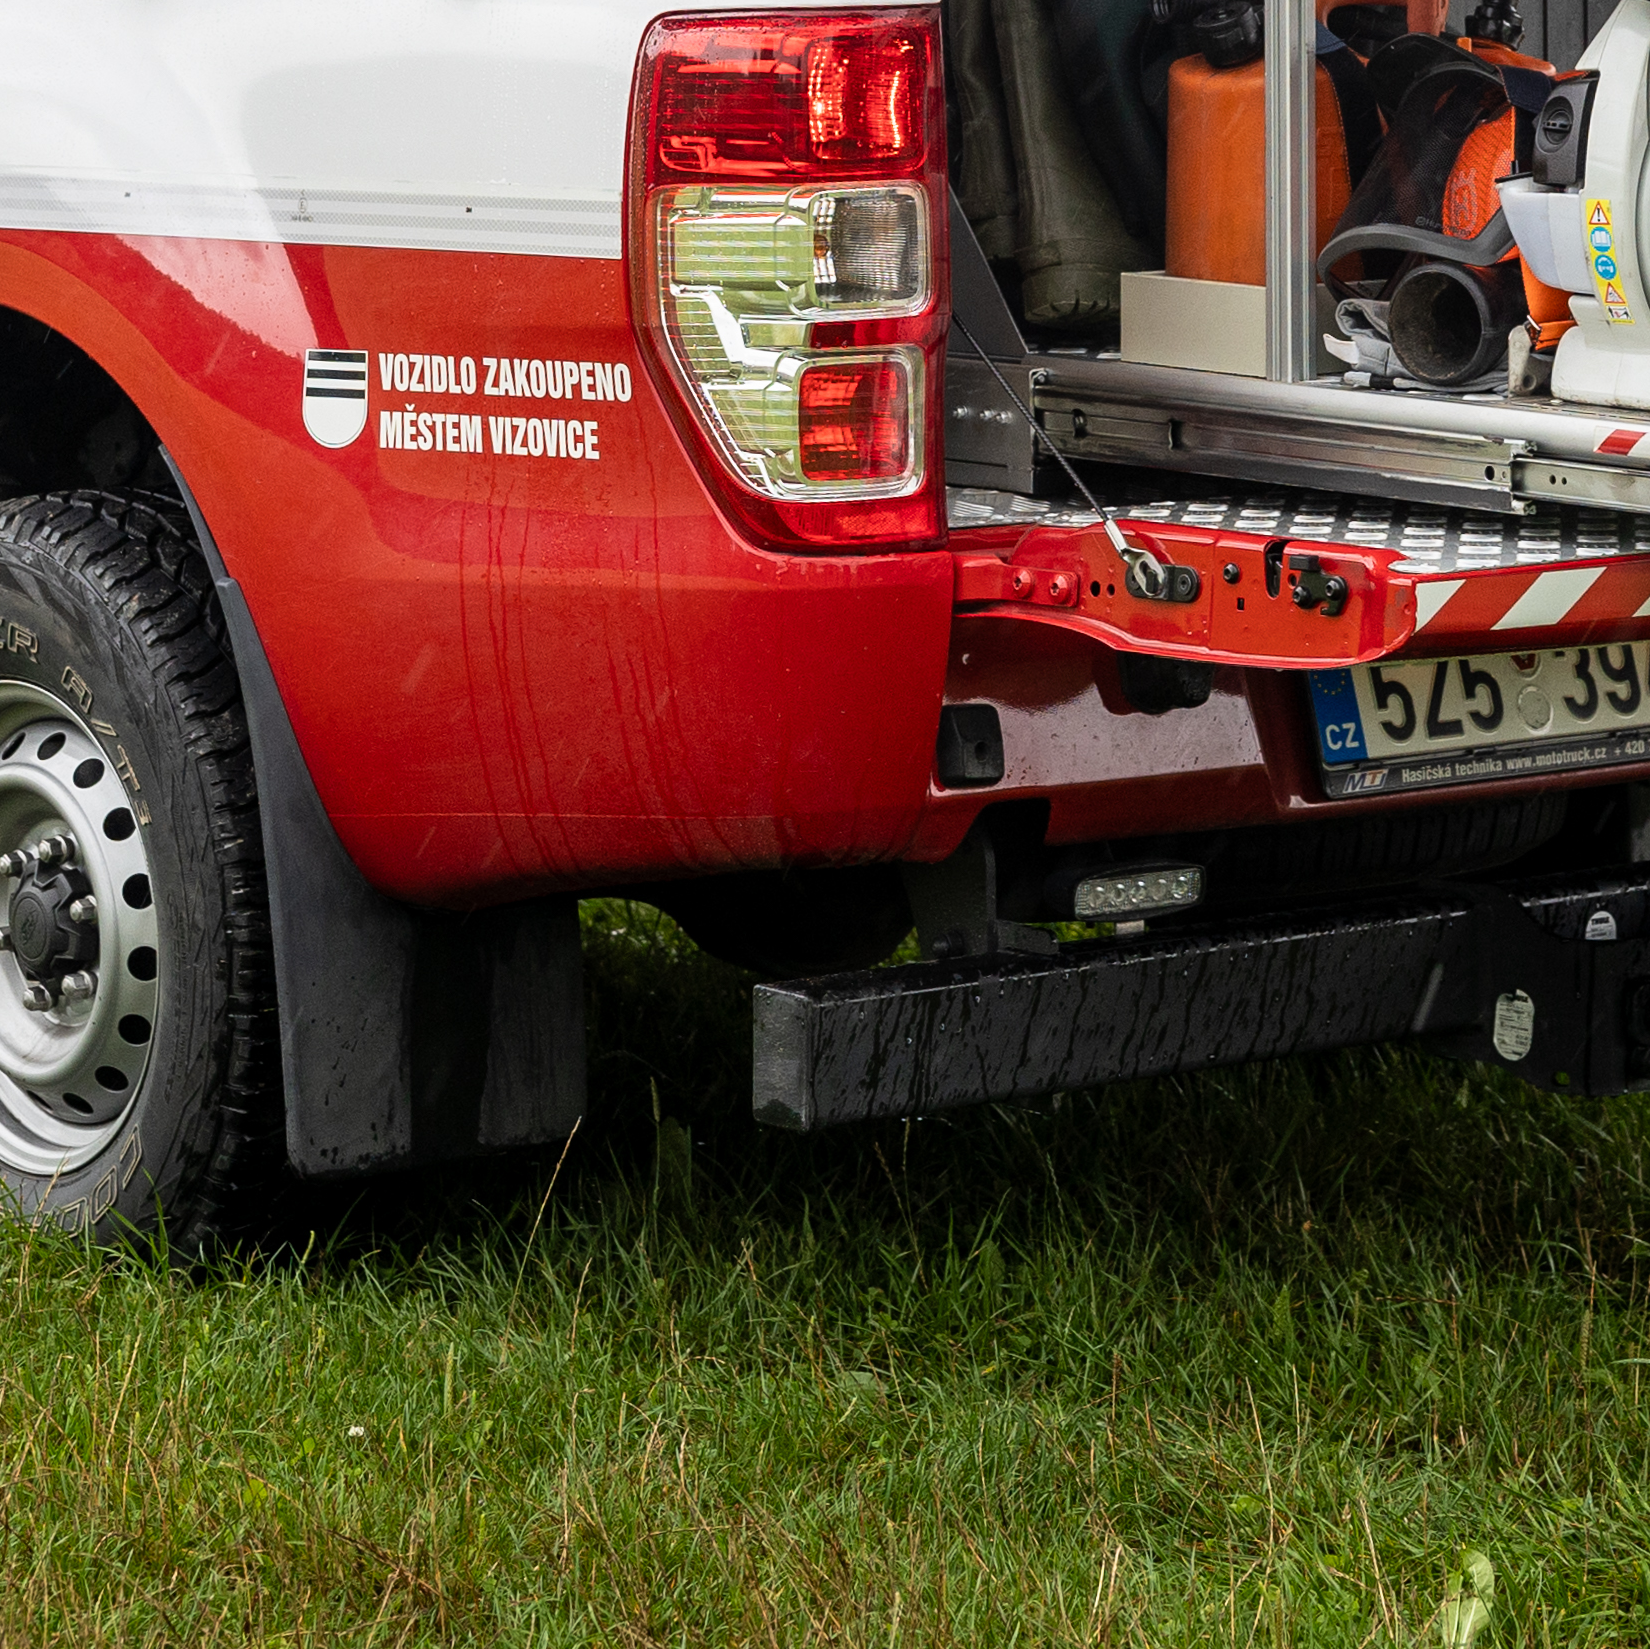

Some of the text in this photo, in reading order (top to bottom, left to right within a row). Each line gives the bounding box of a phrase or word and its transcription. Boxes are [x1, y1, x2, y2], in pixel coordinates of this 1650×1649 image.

[378, 352, 633, 403] VOZIDLO ZAKOUPENO
[379, 403, 600, 460] MĚSTEM VIZOVICE
[1325, 722, 1360, 751] CZ
[1401, 762, 1453, 784] Hasičská
[1455, 758, 1503, 777] technika
[1505, 745, 1608, 771] www.mototruck.cz
[1624, 739, 1646, 755] 420
